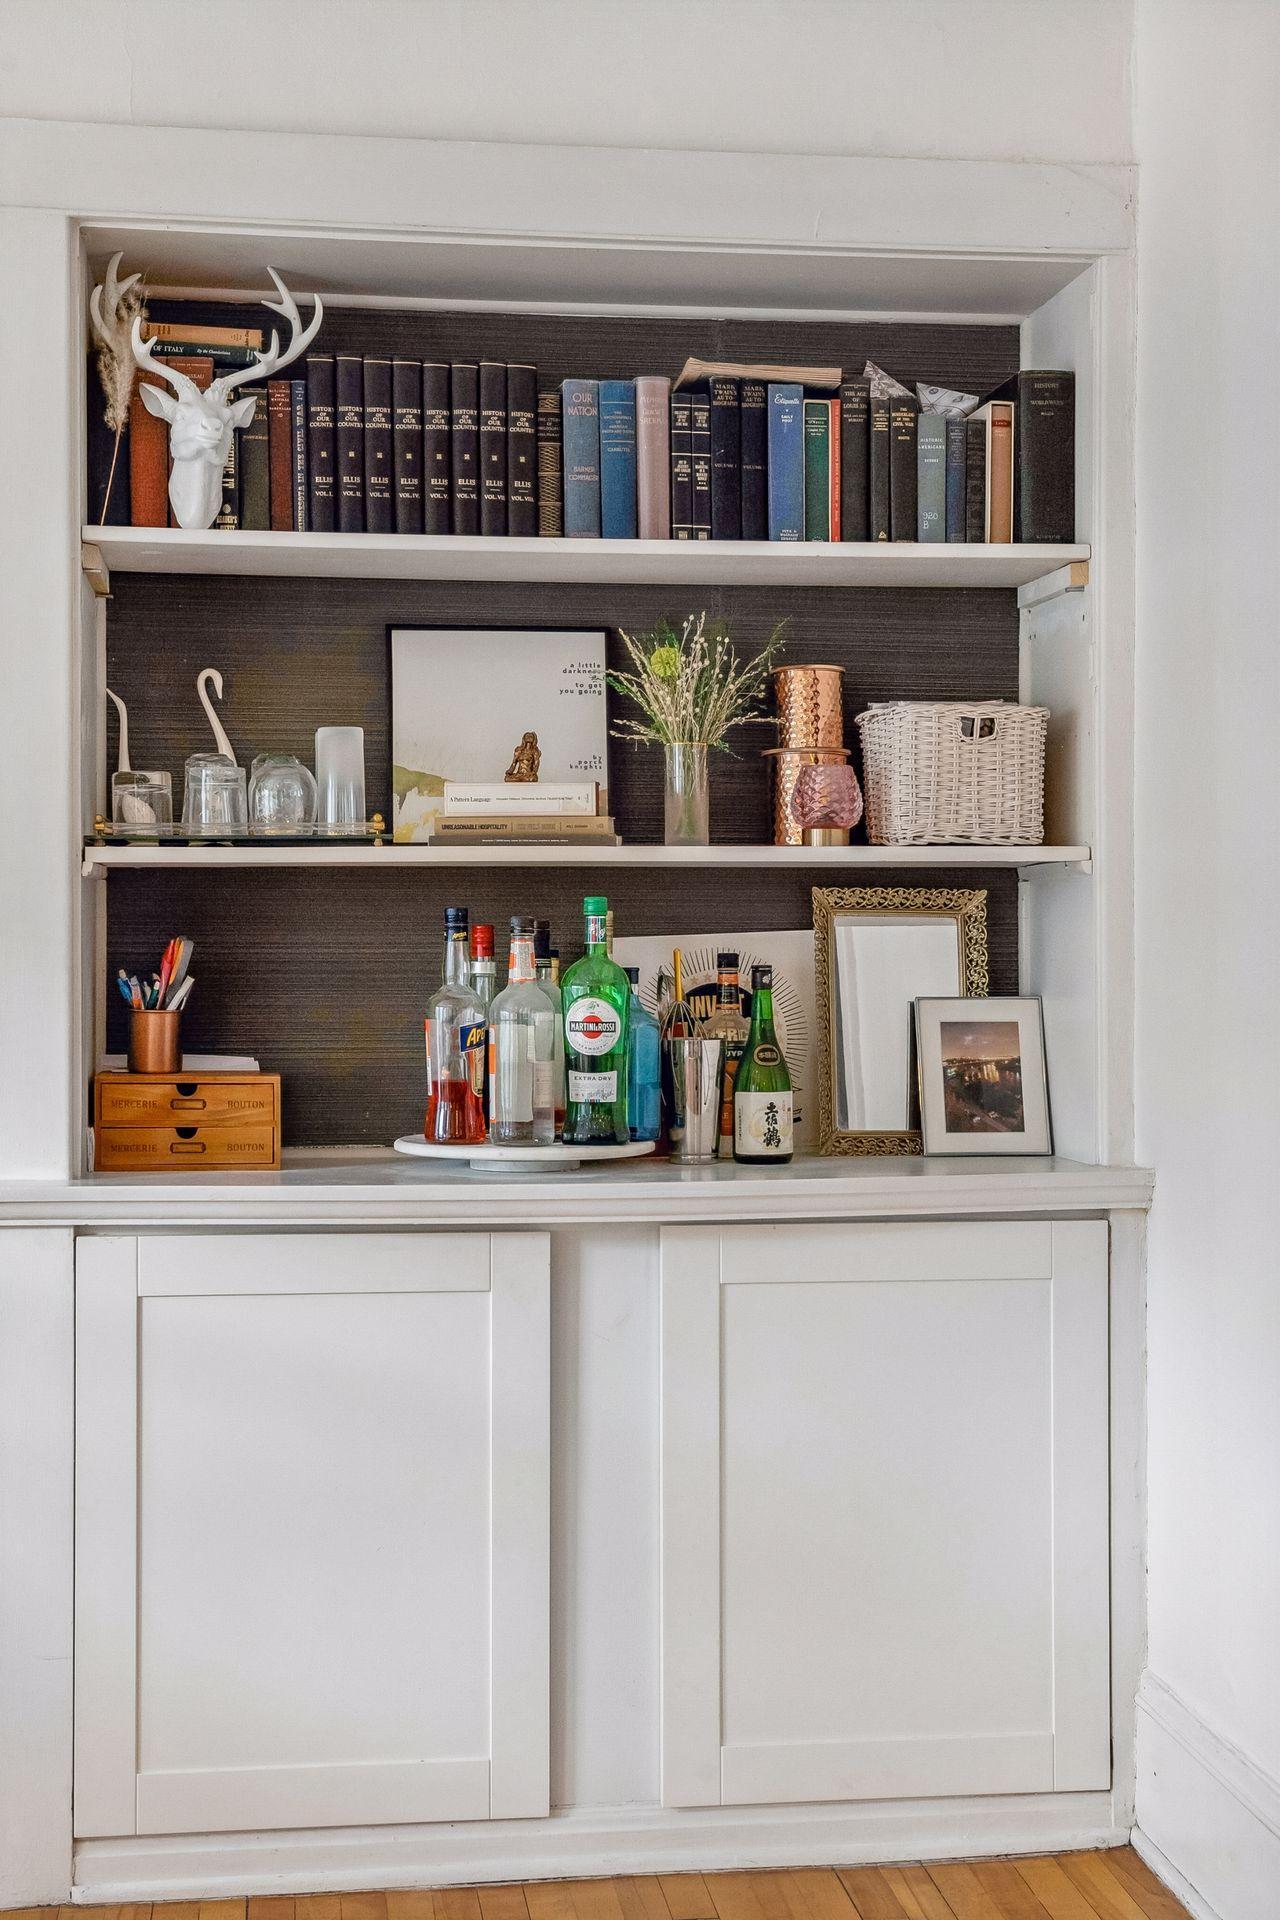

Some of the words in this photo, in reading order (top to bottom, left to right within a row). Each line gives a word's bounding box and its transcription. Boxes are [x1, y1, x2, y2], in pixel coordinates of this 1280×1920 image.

[572, 393, 593, 403] OUR
[567, 406, 598, 416] NATION
[922, 512, 938, 520] 920
[923, 520, 929, 529] B
[690, 993, 745, 1018] INVT
[112, 1100, 158, 1109] MERCERIE
[227, 1100, 265, 1109] BOUTON
[763, 1102, 782, 1147] 土佐鶴
[111, 1144, 157, 1152] MERCERIE
